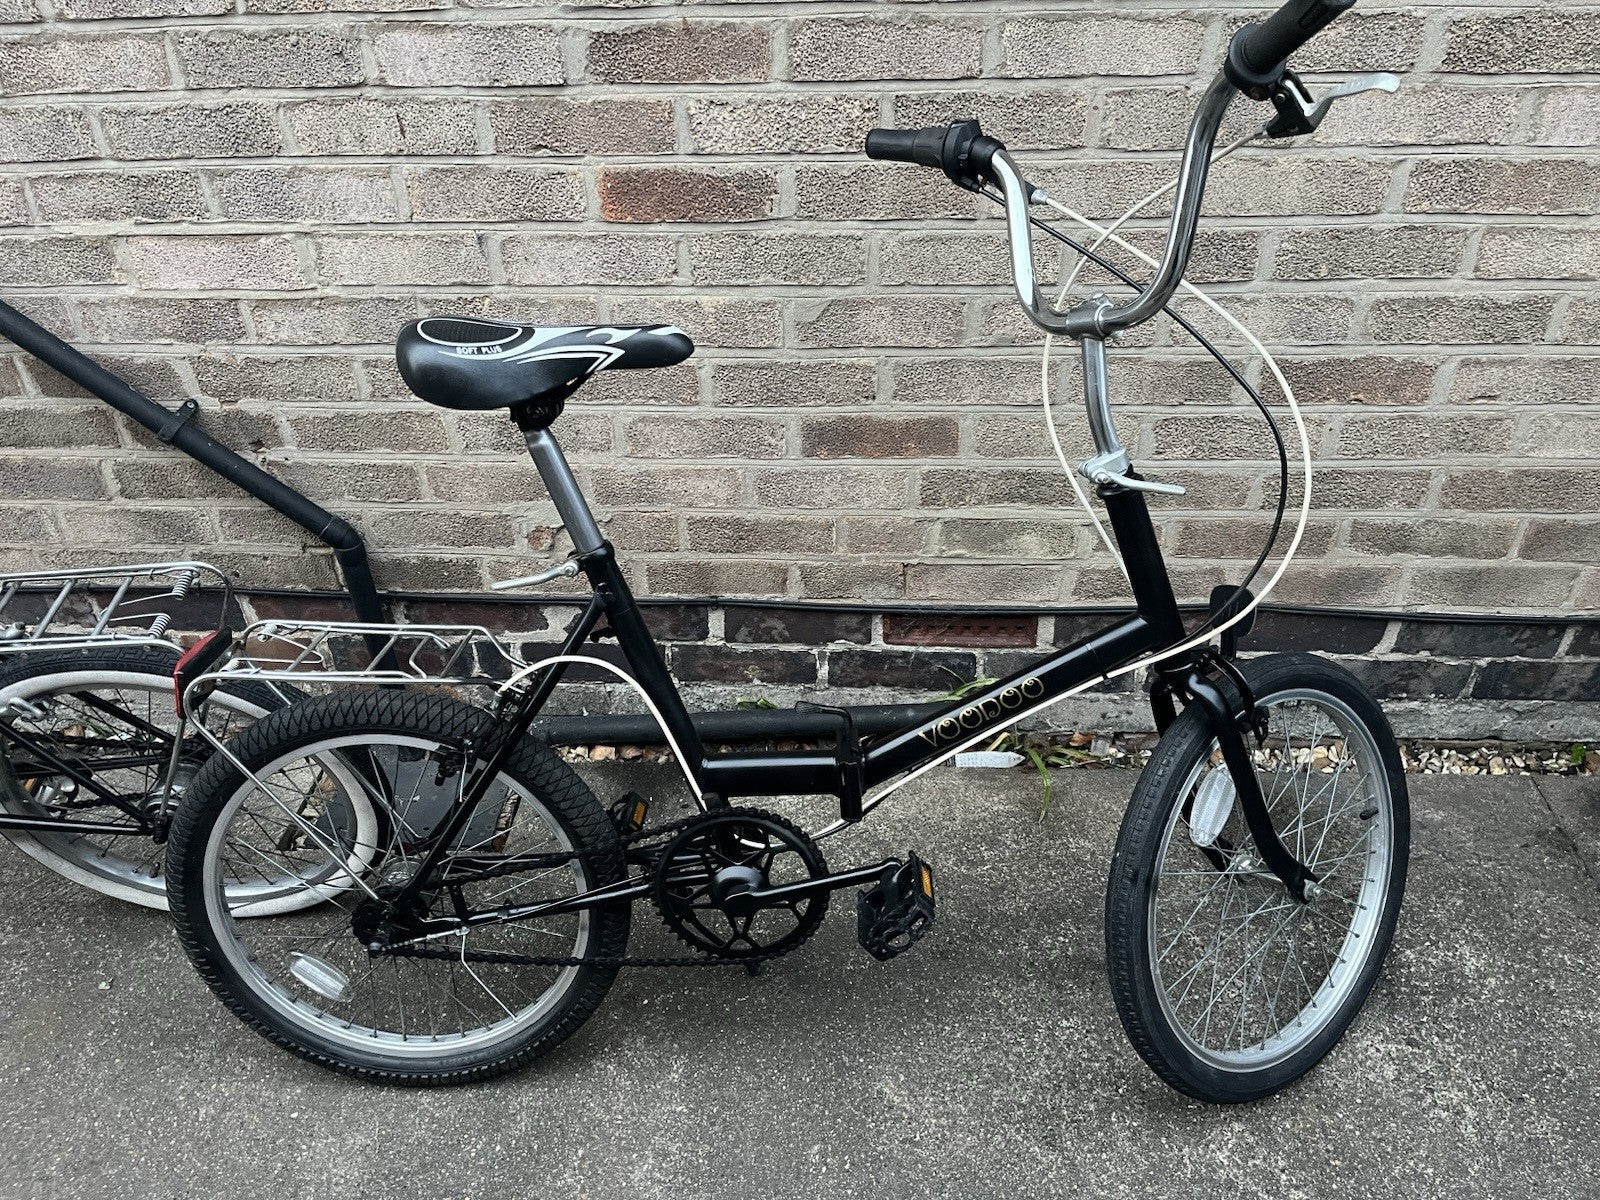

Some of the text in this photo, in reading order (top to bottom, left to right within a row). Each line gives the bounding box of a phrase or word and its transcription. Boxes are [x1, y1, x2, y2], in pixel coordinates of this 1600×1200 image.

[456, 345, 502, 354] SOFT PLUS
[918, 677, 1044, 747] VOODOO
